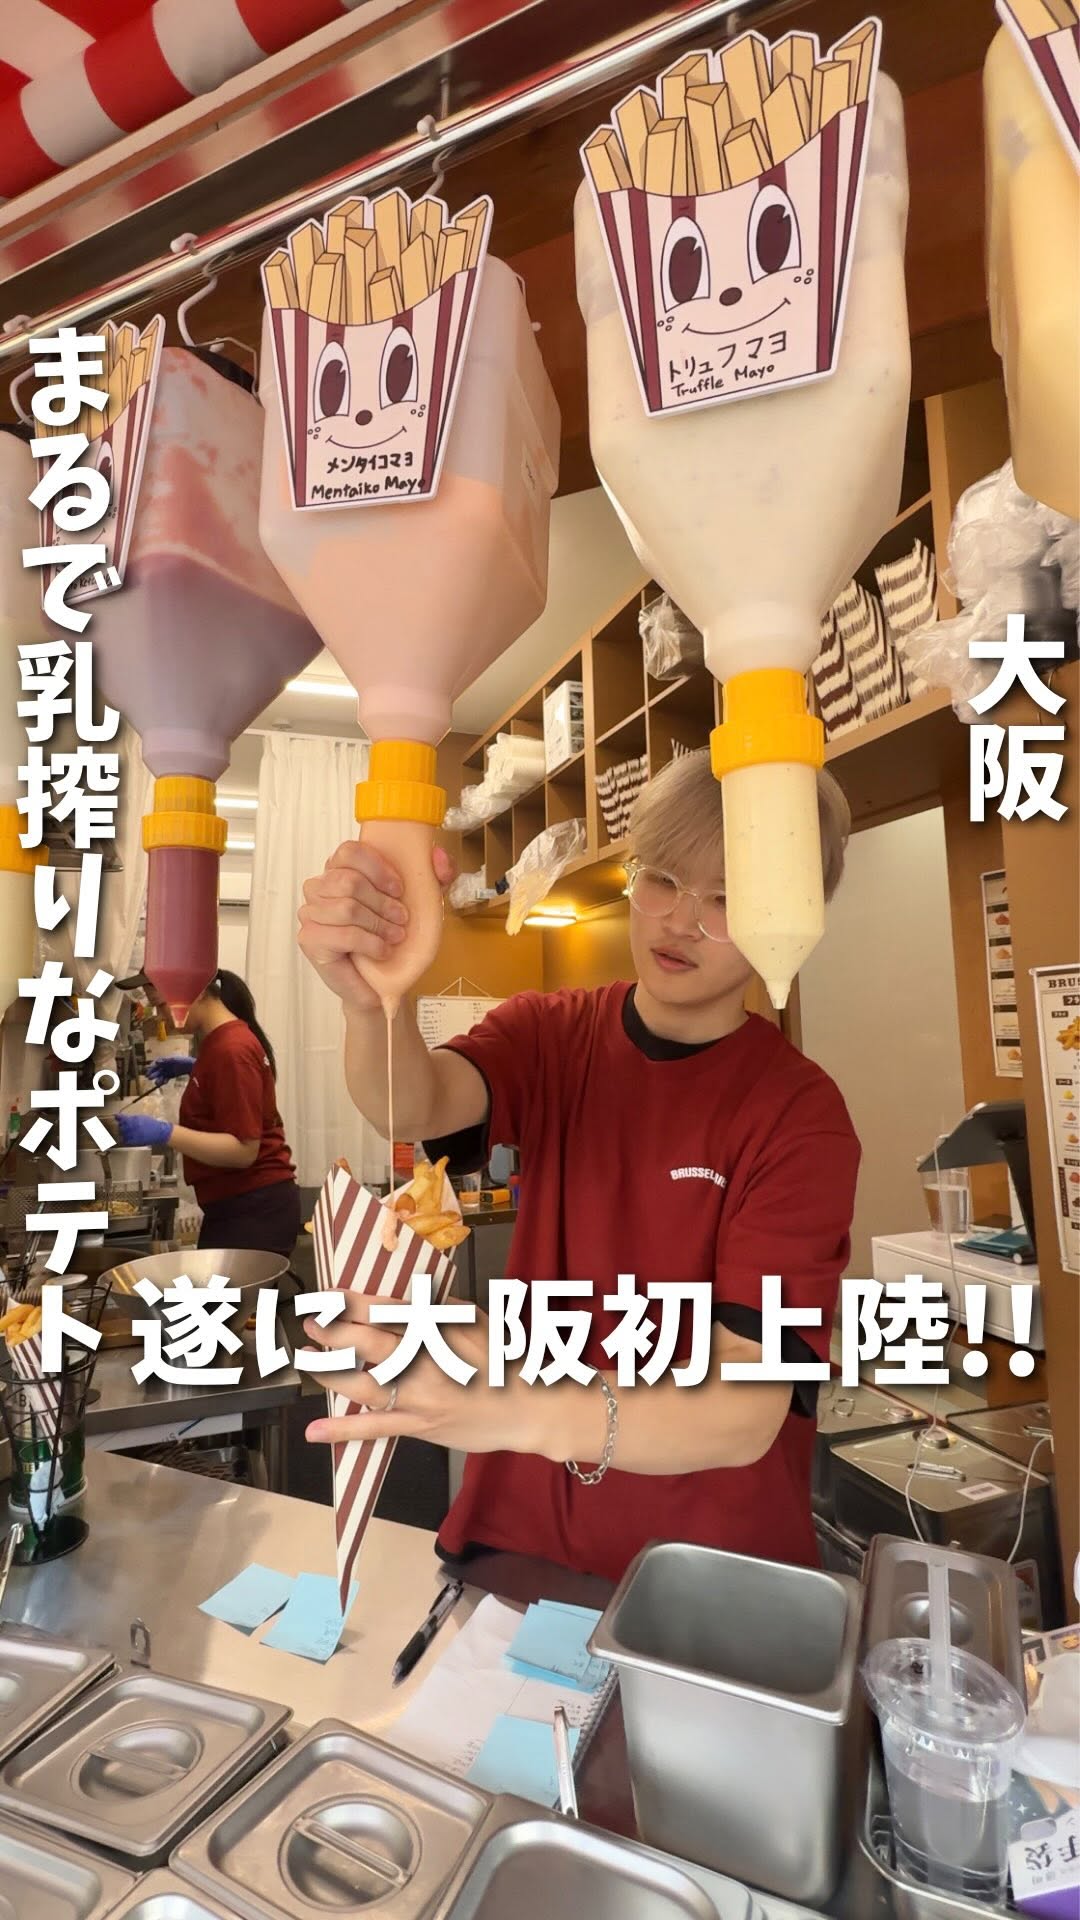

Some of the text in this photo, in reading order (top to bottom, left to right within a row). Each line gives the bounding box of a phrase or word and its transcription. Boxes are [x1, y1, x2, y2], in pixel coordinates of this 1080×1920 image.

[669, 330, 787, 383] トリュフマヨ
[671, 364, 775, 397] Truffle Mayo
[327, 451, 413, 474] メンタイコマヨ
[311, 476, 426, 500] Mentaiko Mayo
